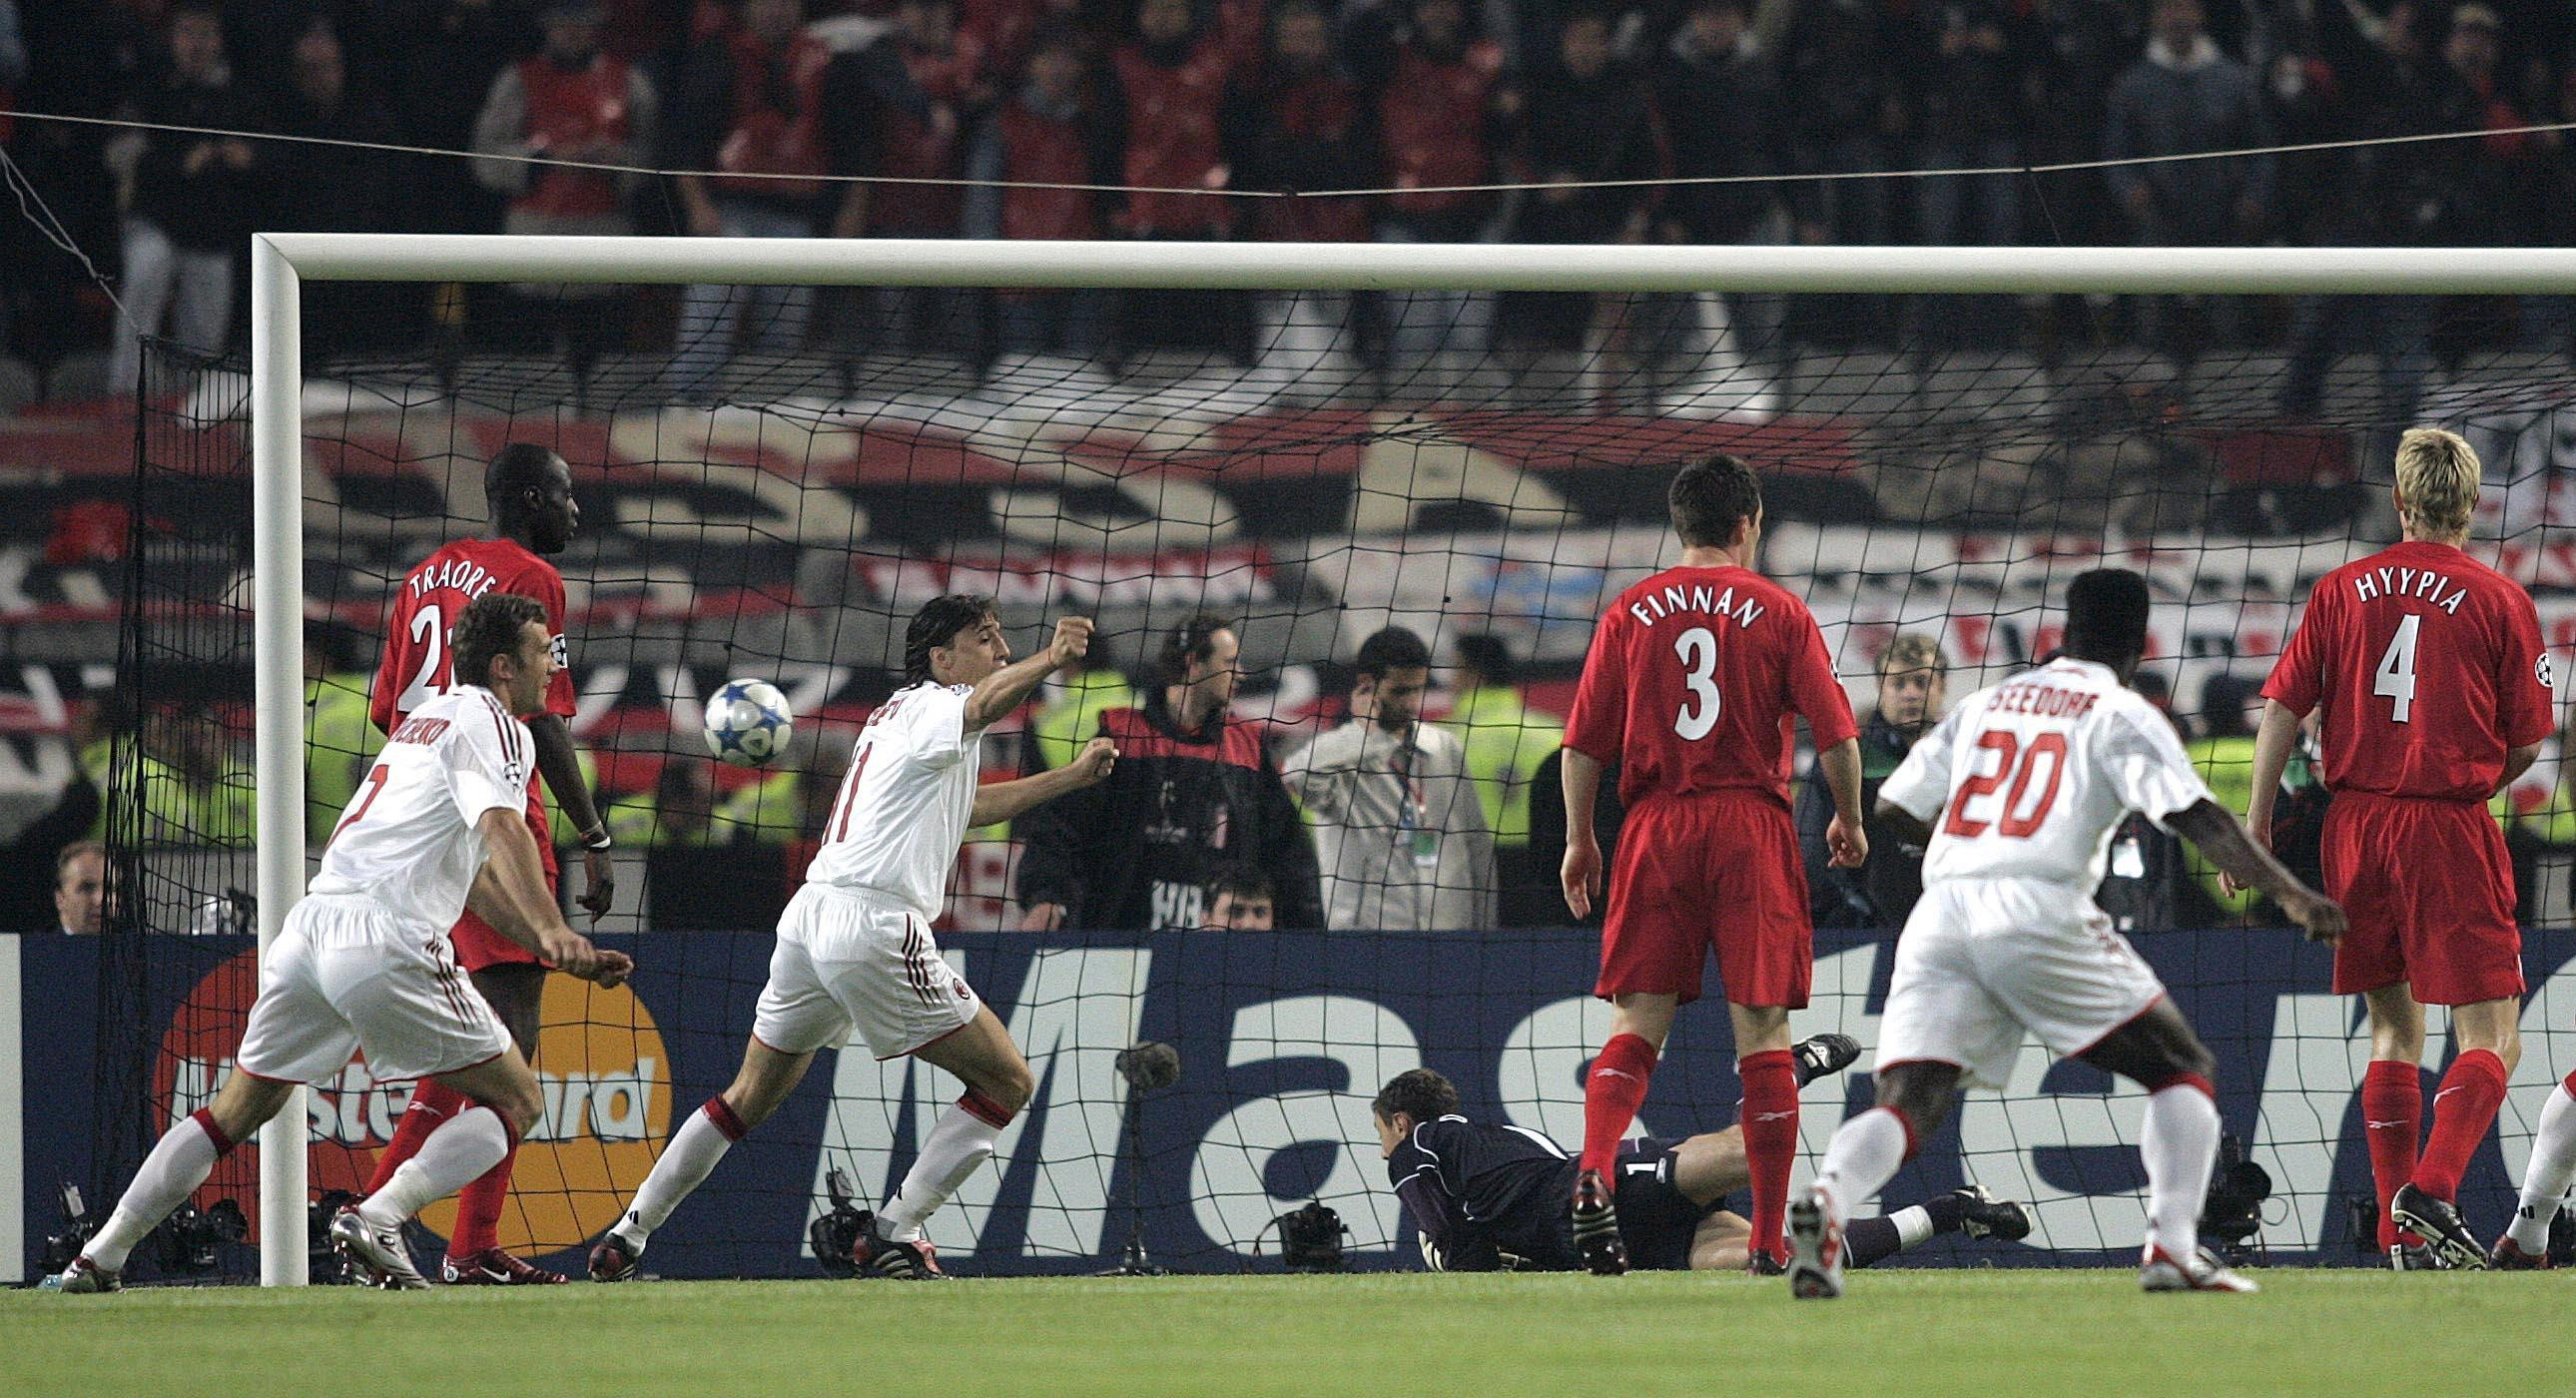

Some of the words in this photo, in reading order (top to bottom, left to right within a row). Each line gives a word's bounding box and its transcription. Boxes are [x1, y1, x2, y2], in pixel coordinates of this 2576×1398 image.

[1629, 584, 1764, 628] FINNAN
[2354, 566, 2467, 615] HYYPIA
[397, 604, 456, 712] 2
[1674, 627, 1720, 741] 3
[1987, 683, 2100, 719] SEEDORF
[2373, 614, 2421, 723] 4
[324, 764, 390, 851] 7
[1944, 729, 2067, 838] 20
[171, 1056, 657, 1144] Msteard
[802, 943, 2576, 1257] Mater
[1625, 1162, 1657, 1175] 1
